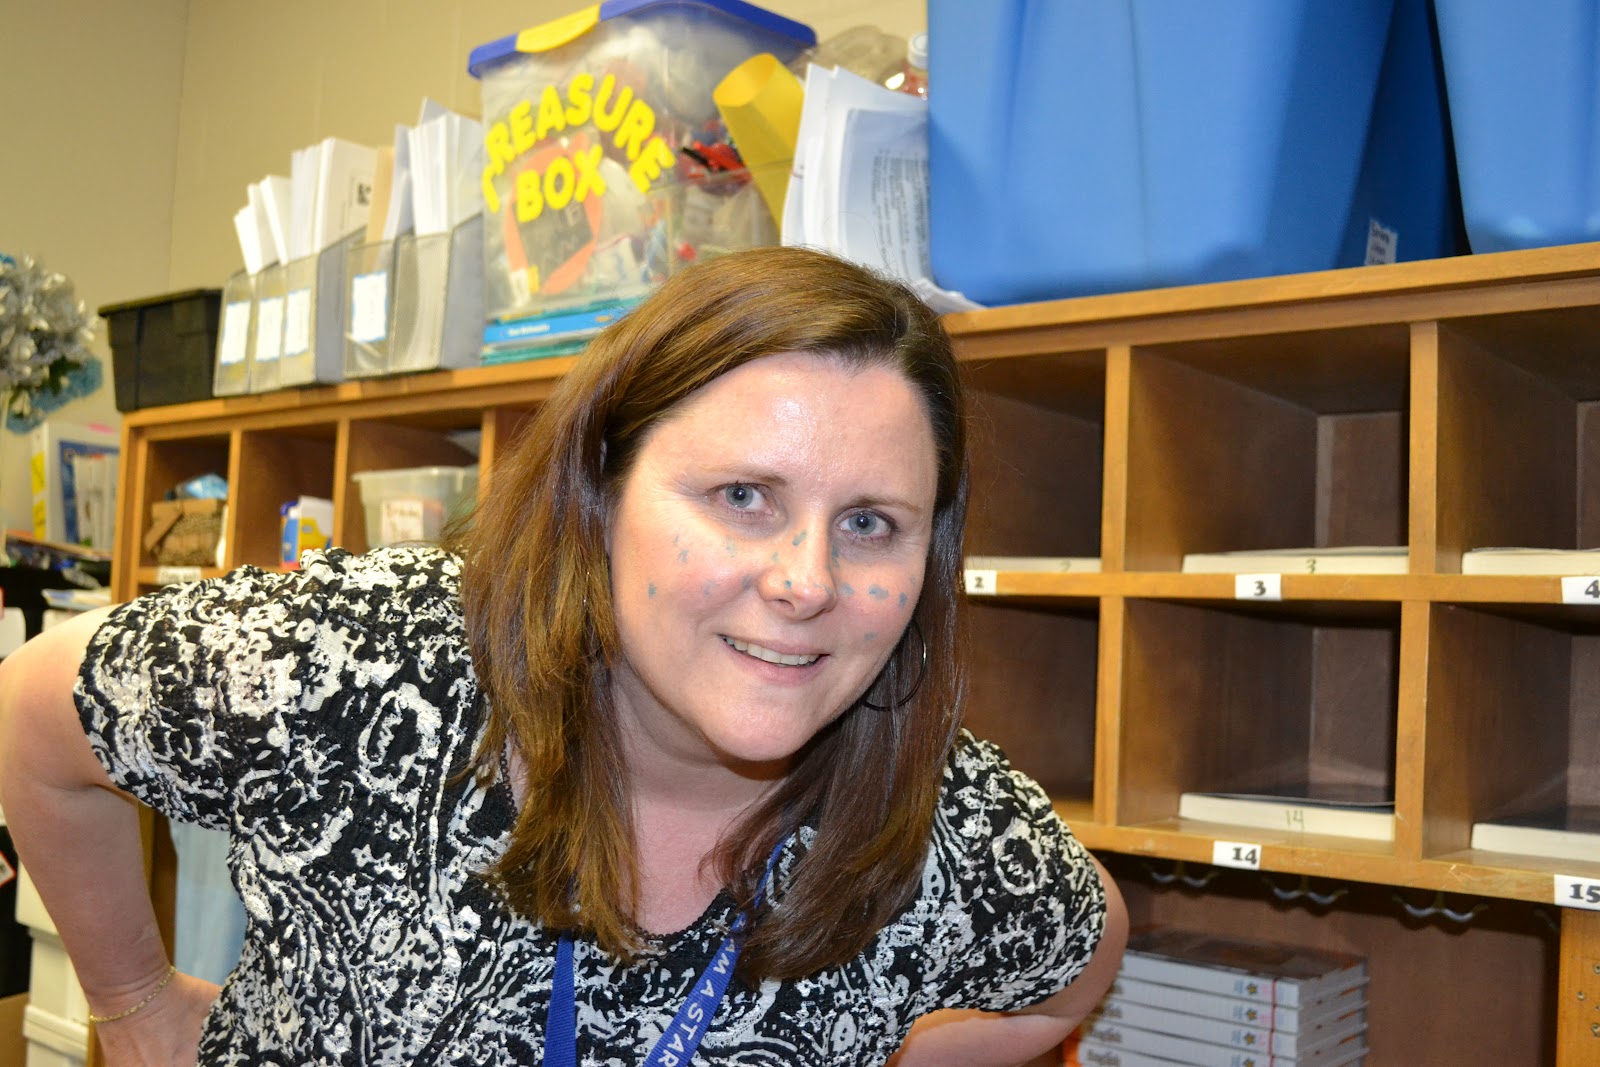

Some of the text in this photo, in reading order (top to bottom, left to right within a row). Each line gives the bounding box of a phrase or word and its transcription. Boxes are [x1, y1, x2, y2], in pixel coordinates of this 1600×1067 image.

[516, 143, 606, 223] BOX
[1306, 558, 1317, 575] 3
[974, 576, 984, 589] 2
[1253, 580, 1267, 597] 3
[1584, 579, 1600, 599] 4
[1286, 809, 1305, 830] 14
[1232, 846, 1258, 866] 14
[1569, 883, 1600, 904] 15
[700, 979, 715, 998] A
[658, 1002, 704, 1067] STAR
